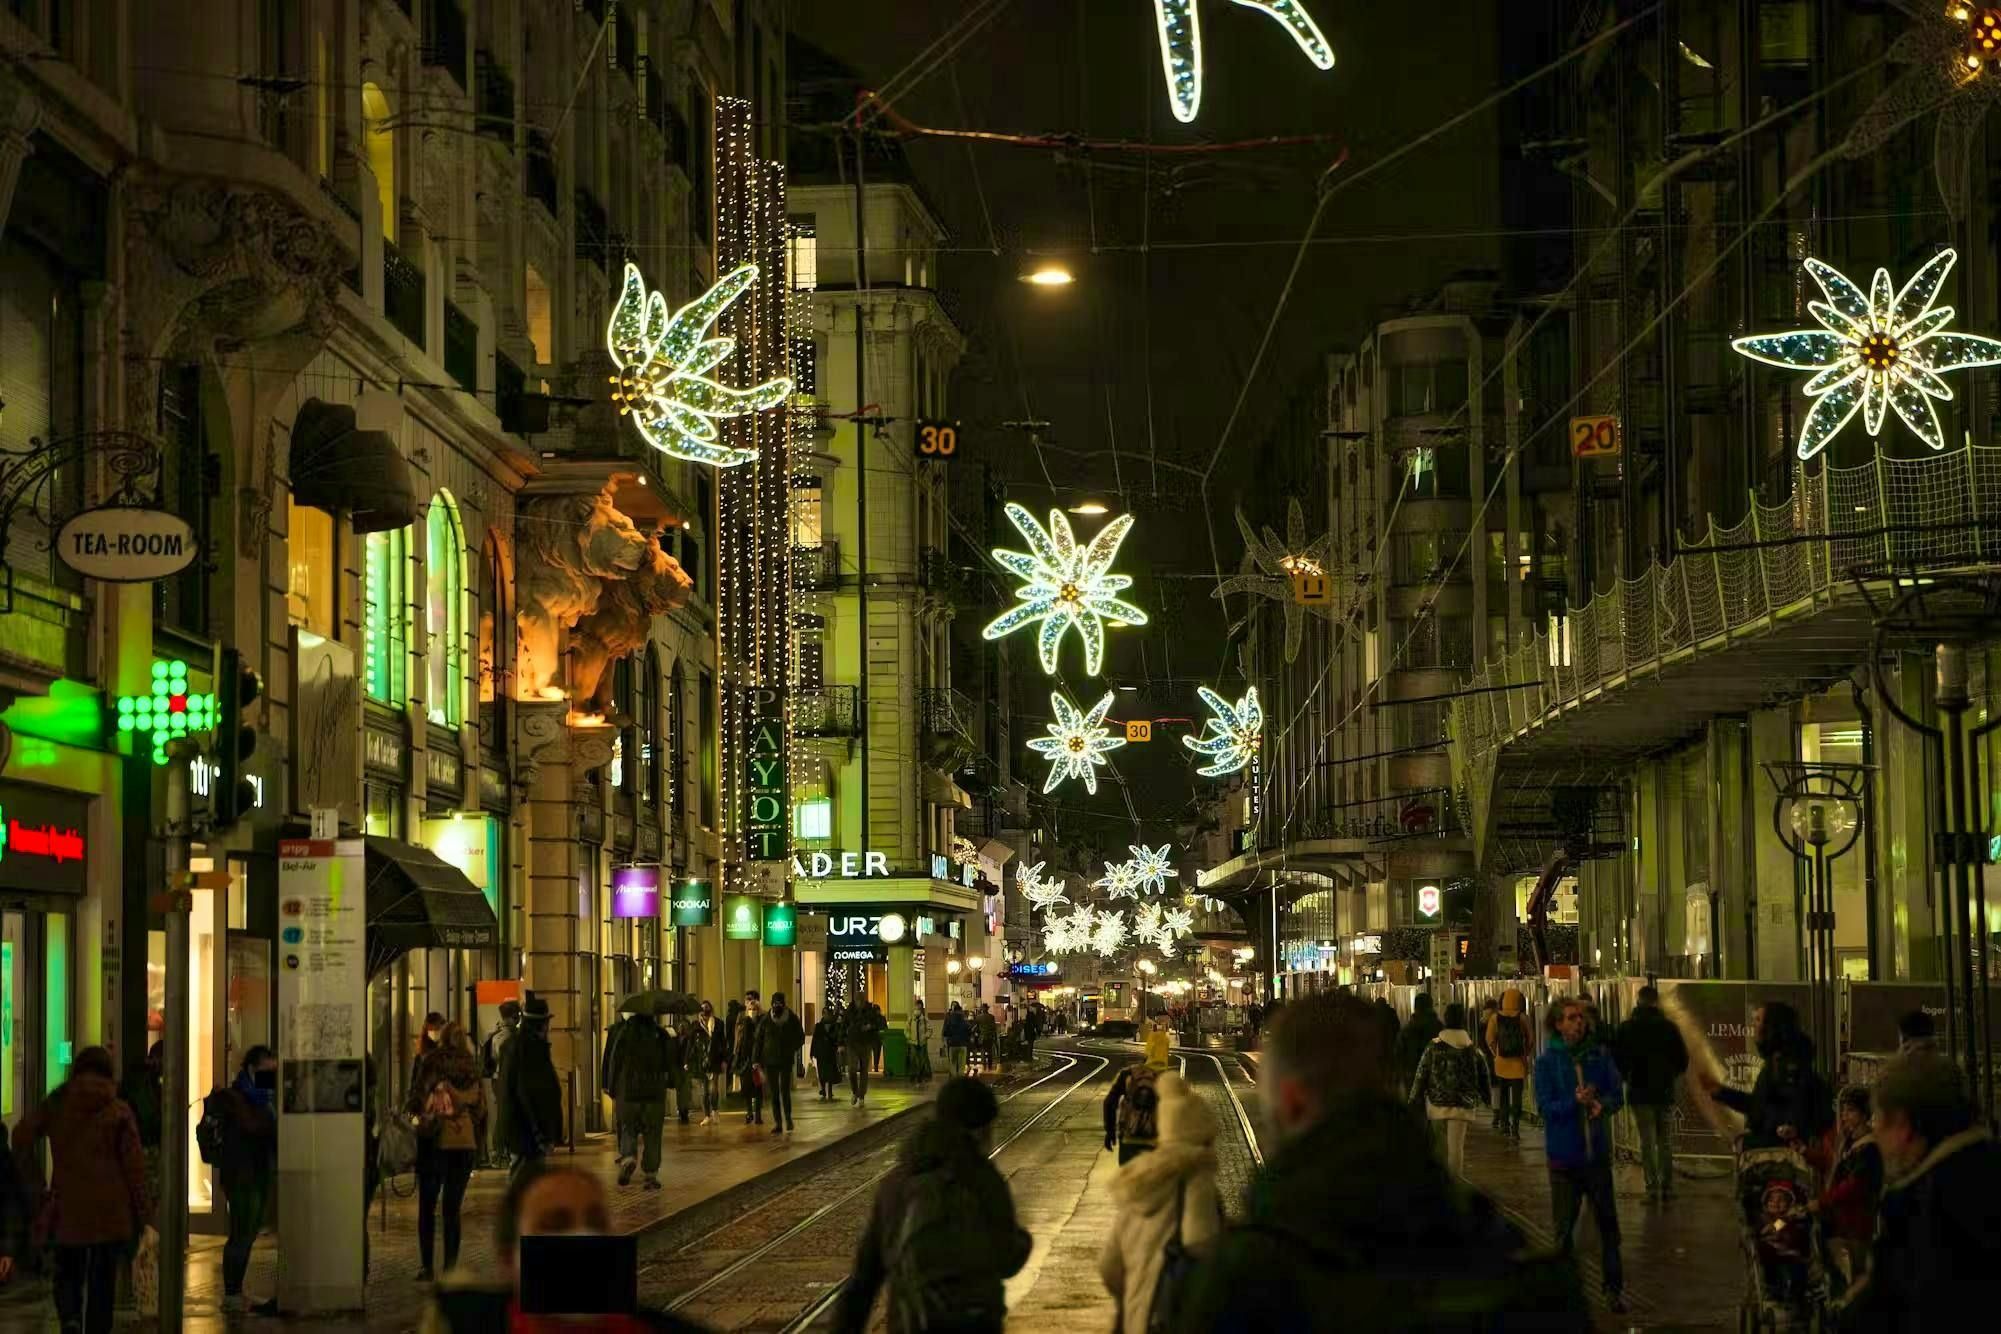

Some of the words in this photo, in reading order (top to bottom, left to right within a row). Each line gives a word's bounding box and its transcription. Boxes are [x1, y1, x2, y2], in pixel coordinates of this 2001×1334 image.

[920, 426, 956, 455] 30
[1575, 420, 1615, 450] 20
[72, 533, 183, 556] TEA-ROOM
[1130, 725, 1148, 738] 30
[750, 689, 781, 857] PAYOT
[1252, 755, 1260, 814] SUITES
[673, 898, 710, 910] KOOKAÏ
